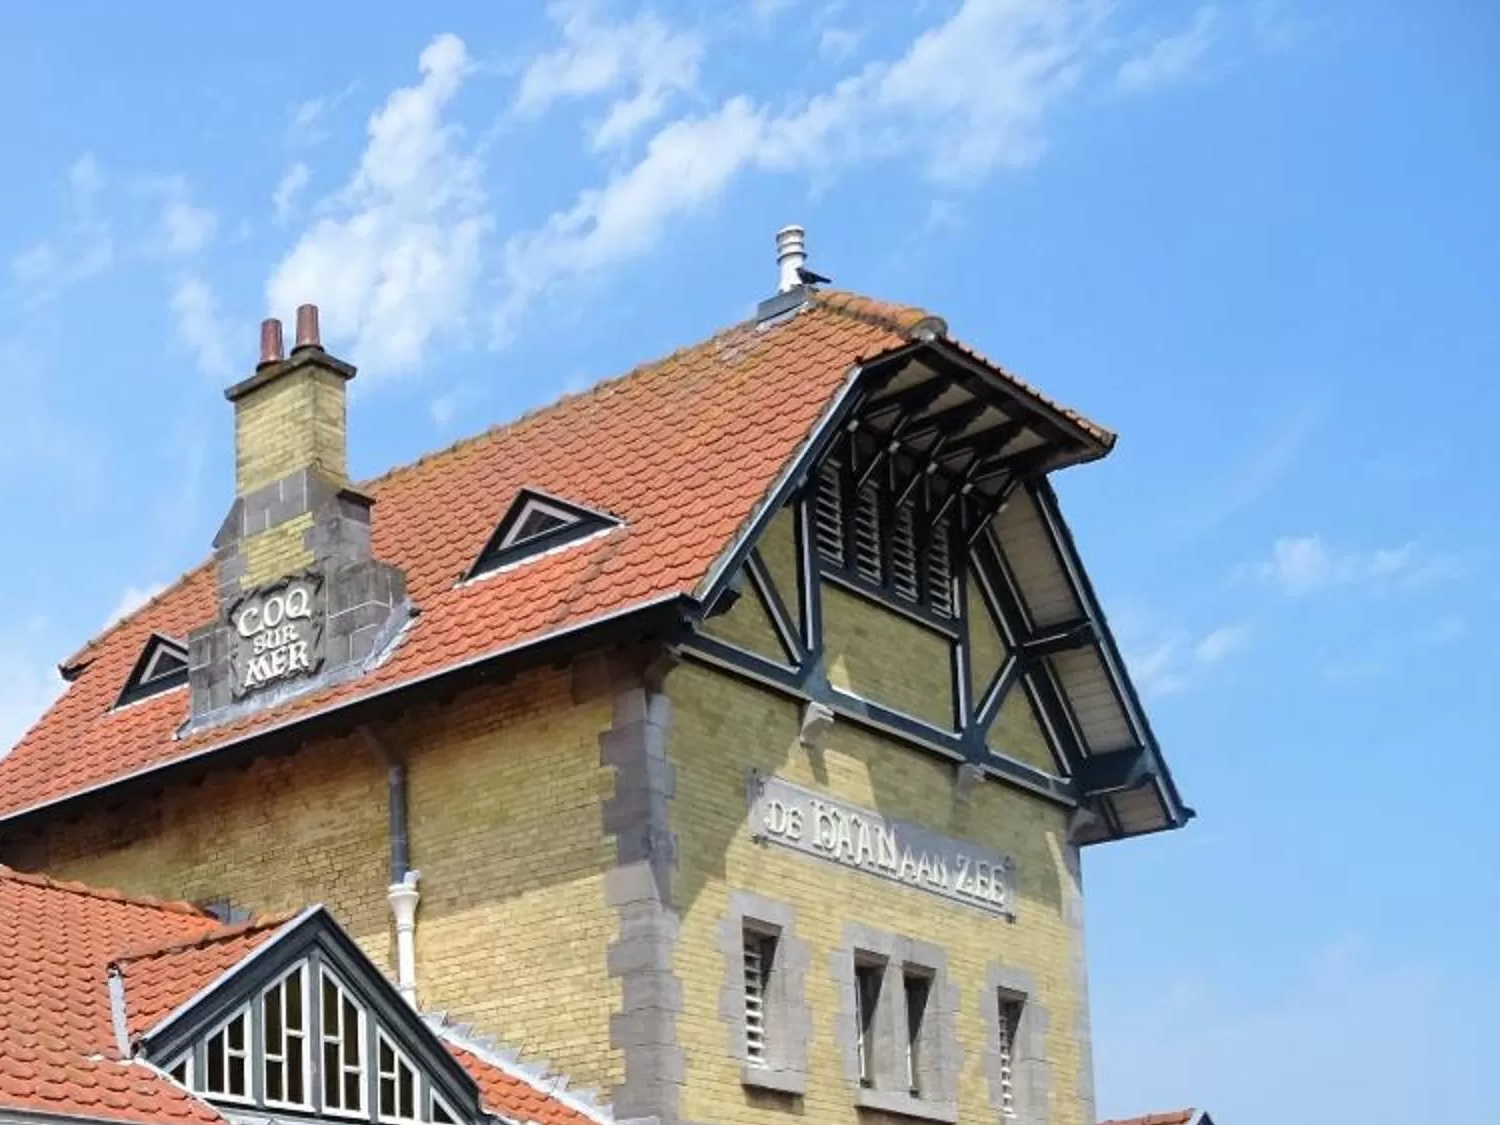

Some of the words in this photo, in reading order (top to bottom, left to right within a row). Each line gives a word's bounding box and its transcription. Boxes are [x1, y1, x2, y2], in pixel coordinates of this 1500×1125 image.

[238, 588, 311, 636] COQ
[253, 623, 299, 654] SUR
[244, 640, 309, 687] MER
[763, 799, 804, 840] DE
